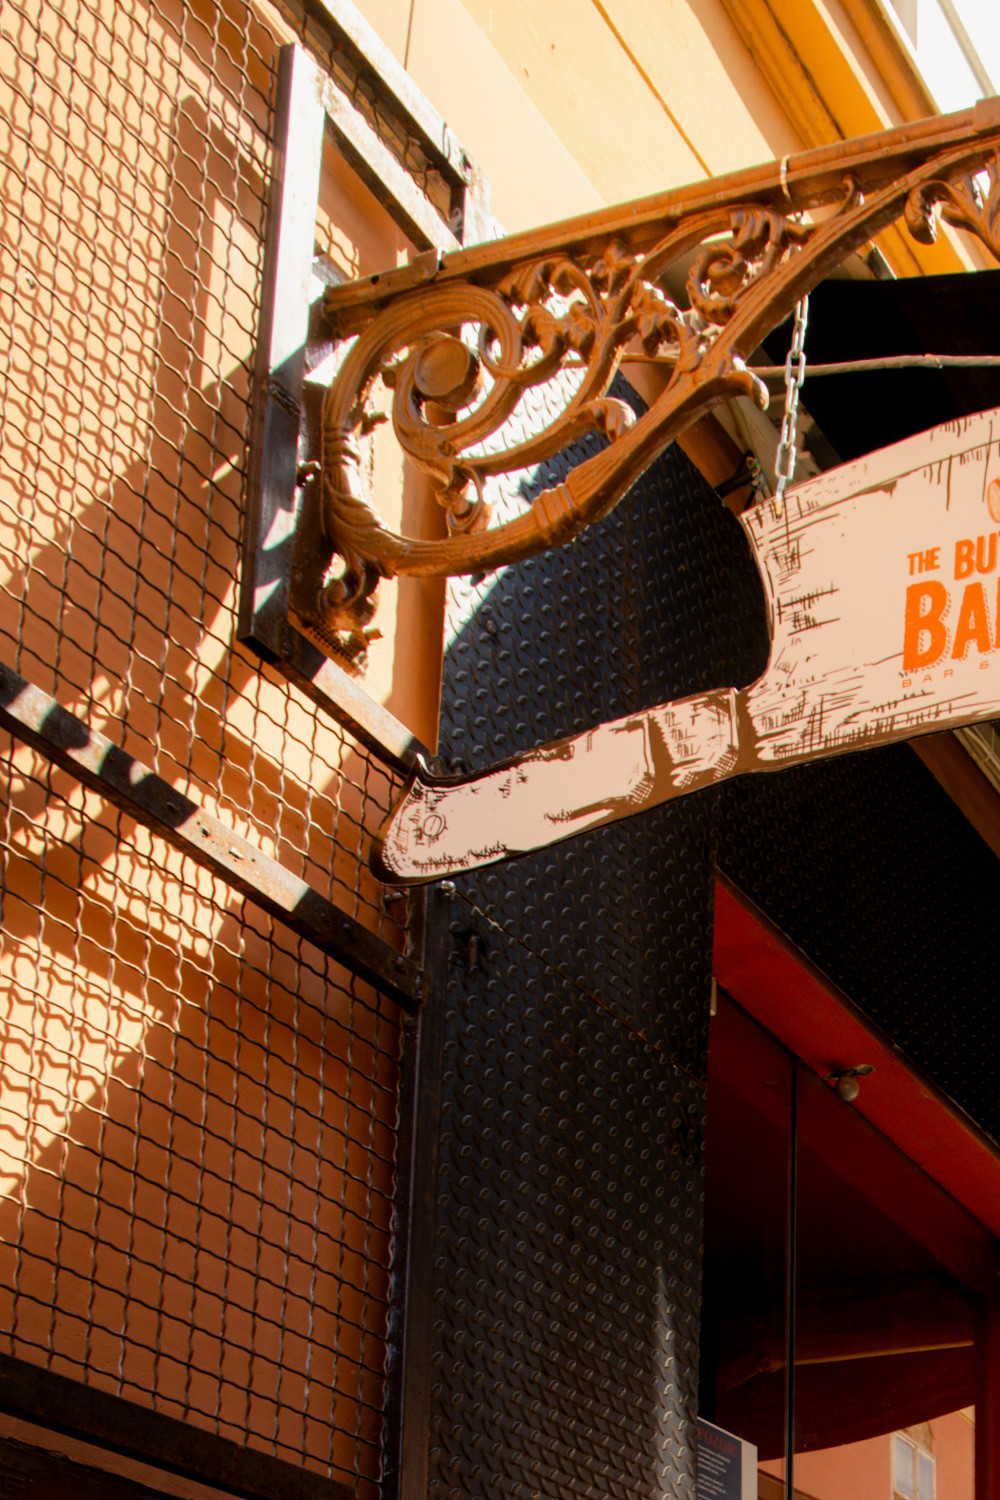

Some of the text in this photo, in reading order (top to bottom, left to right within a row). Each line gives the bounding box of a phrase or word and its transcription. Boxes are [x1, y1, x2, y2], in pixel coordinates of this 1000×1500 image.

[907, 546, 942, 576] THE
[901, 668, 956, 690] BAR
[978, 660, 990, 671] &
